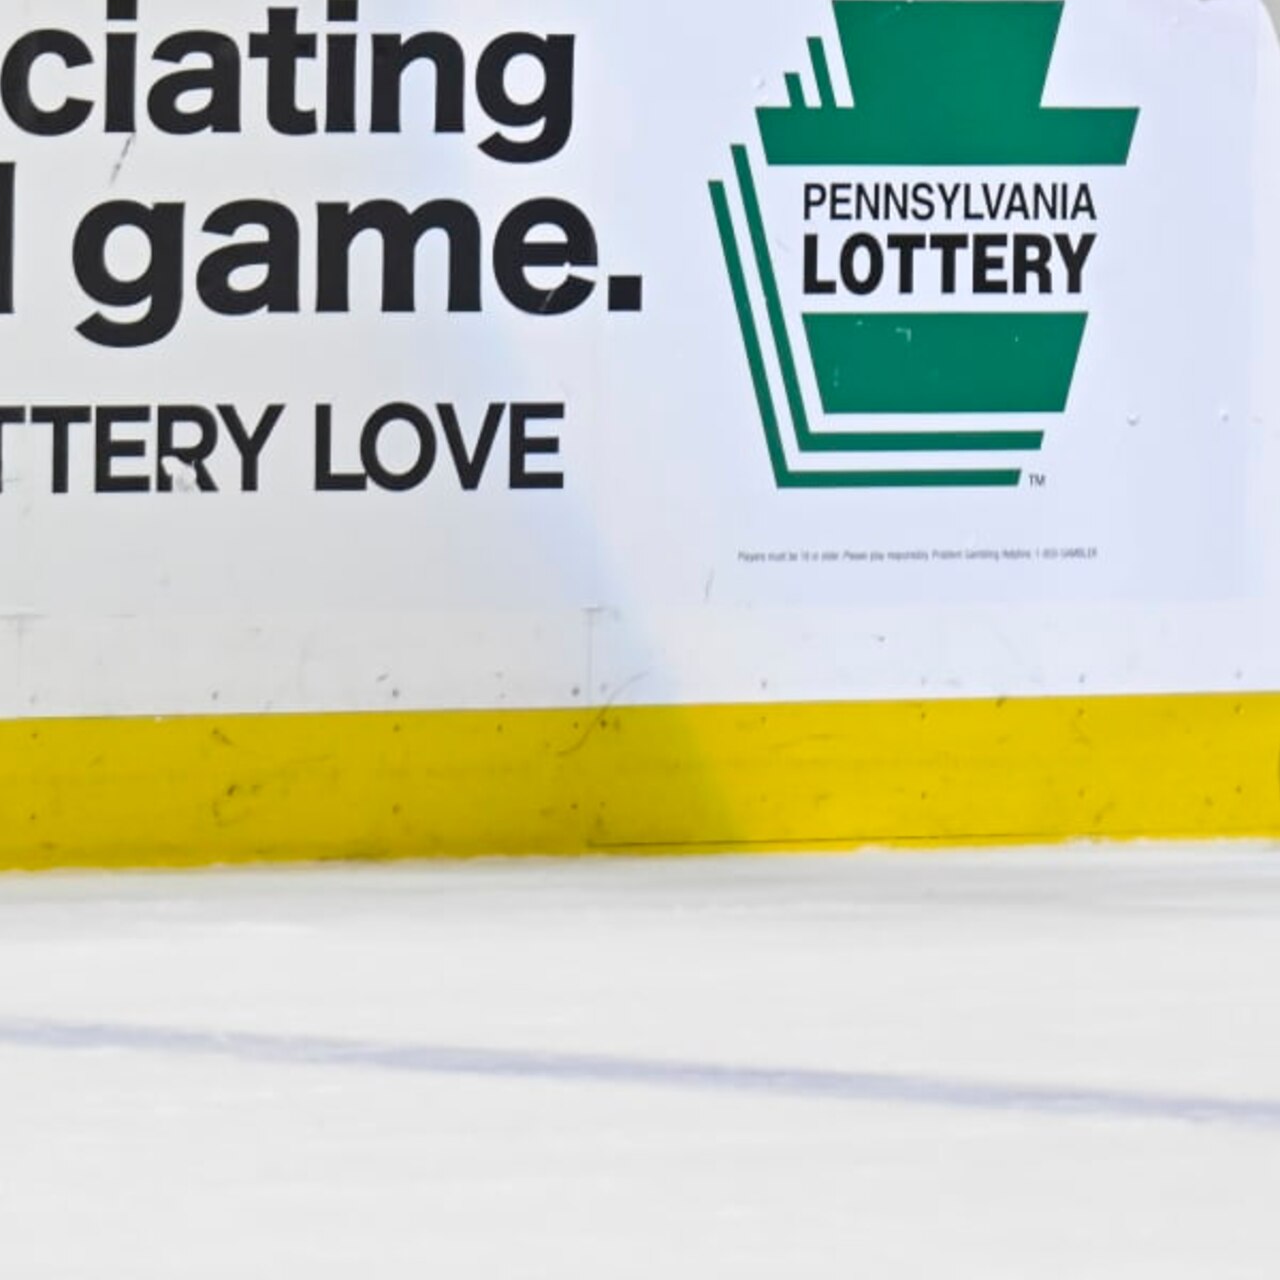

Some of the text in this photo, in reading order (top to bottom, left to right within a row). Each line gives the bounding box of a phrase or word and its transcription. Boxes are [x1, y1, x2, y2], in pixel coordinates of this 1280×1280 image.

[803, 182, 1098, 221] PENNSYLVANIA
[72, 198, 643, 349] game.
[803, 232, 1097, 296] LOTTERY
[314, 401, 565, 492] LOVE
